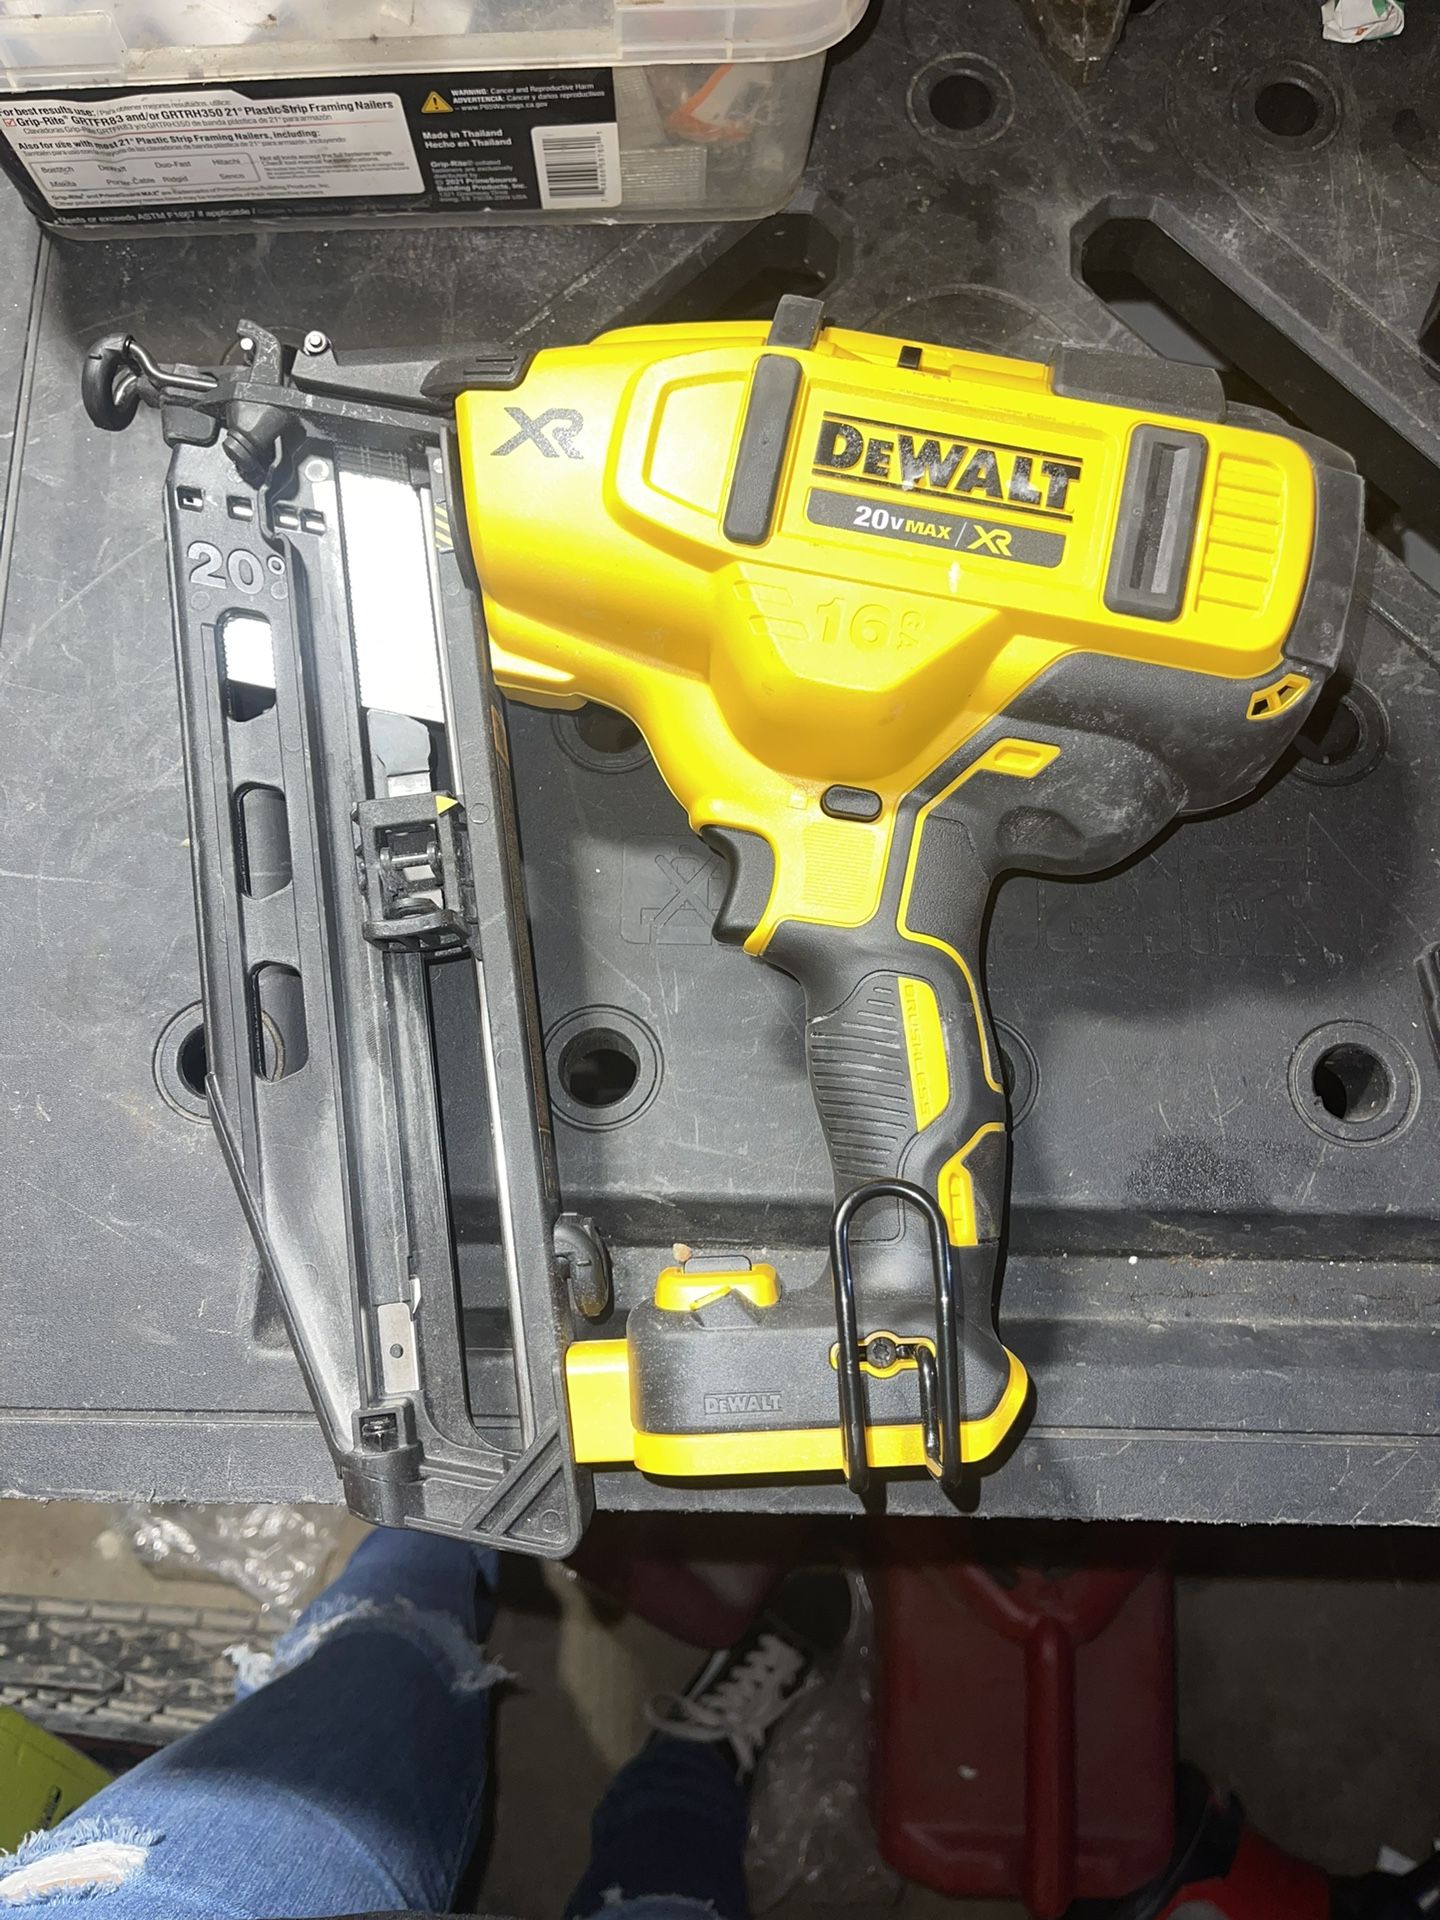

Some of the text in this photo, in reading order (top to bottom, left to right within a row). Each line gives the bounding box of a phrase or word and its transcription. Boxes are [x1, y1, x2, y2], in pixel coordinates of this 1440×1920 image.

[451, 88, 489, 97] WARNING:
[490, 87, 514, 95] Cancer
[530, 83, 574, 93] Reproductive
[575, 81, 594, 90] Harm
[453, 95, 505, 104] ADVERTENCIA:
[560, 91, 605, 100] reproductivos
[13, 107, 38, 116] best
[38, 105, 73, 115] results
[73, 108, 96, 117] use:
[71, 114, 124, 127] GRTFR83
[125, 110, 160, 122] and/or
[161, 107, 224, 120] GRTRH350
[224, 106, 242, 117] 21°
[244, 105, 282, 116] Plastic
[282, 103, 308, 115] Strip
[308, 100, 354, 113] Framing
[355, 100, 394, 111] Nailers
[147, 119, 191, 129] GRTRH350
[192, 119, 202, 128] de
[202, 119, 227, 127] banda
[281, 116, 299, 124] para
[18, 142, 39, 150] Also
[40, 141, 54, 149] for
[55, 141, 73, 149] use
[73, 139, 94, 149] with
[93, 140, 118, 150] most
[135, 136, 169, 145] Plastic
[169, 134, 193, 144] Strip
[193, 133, 234, 143] Framing
[234, 131, 272, 141] Nailers,
[273, 129, 321, 138] including:
[423, 129, 503, 140] Made in Thailand
[425, 140, 456, 149] Hecho
[470, 138, 513, 147] Thailand
[154, 160, 192, 169] Duo-Fast
[212, 158, 240, 166] Hitachi
[138, 211, 166, 220] ASTM
[490, 406, 584, 460] XR
[966, 524, 1013, 557] XR
